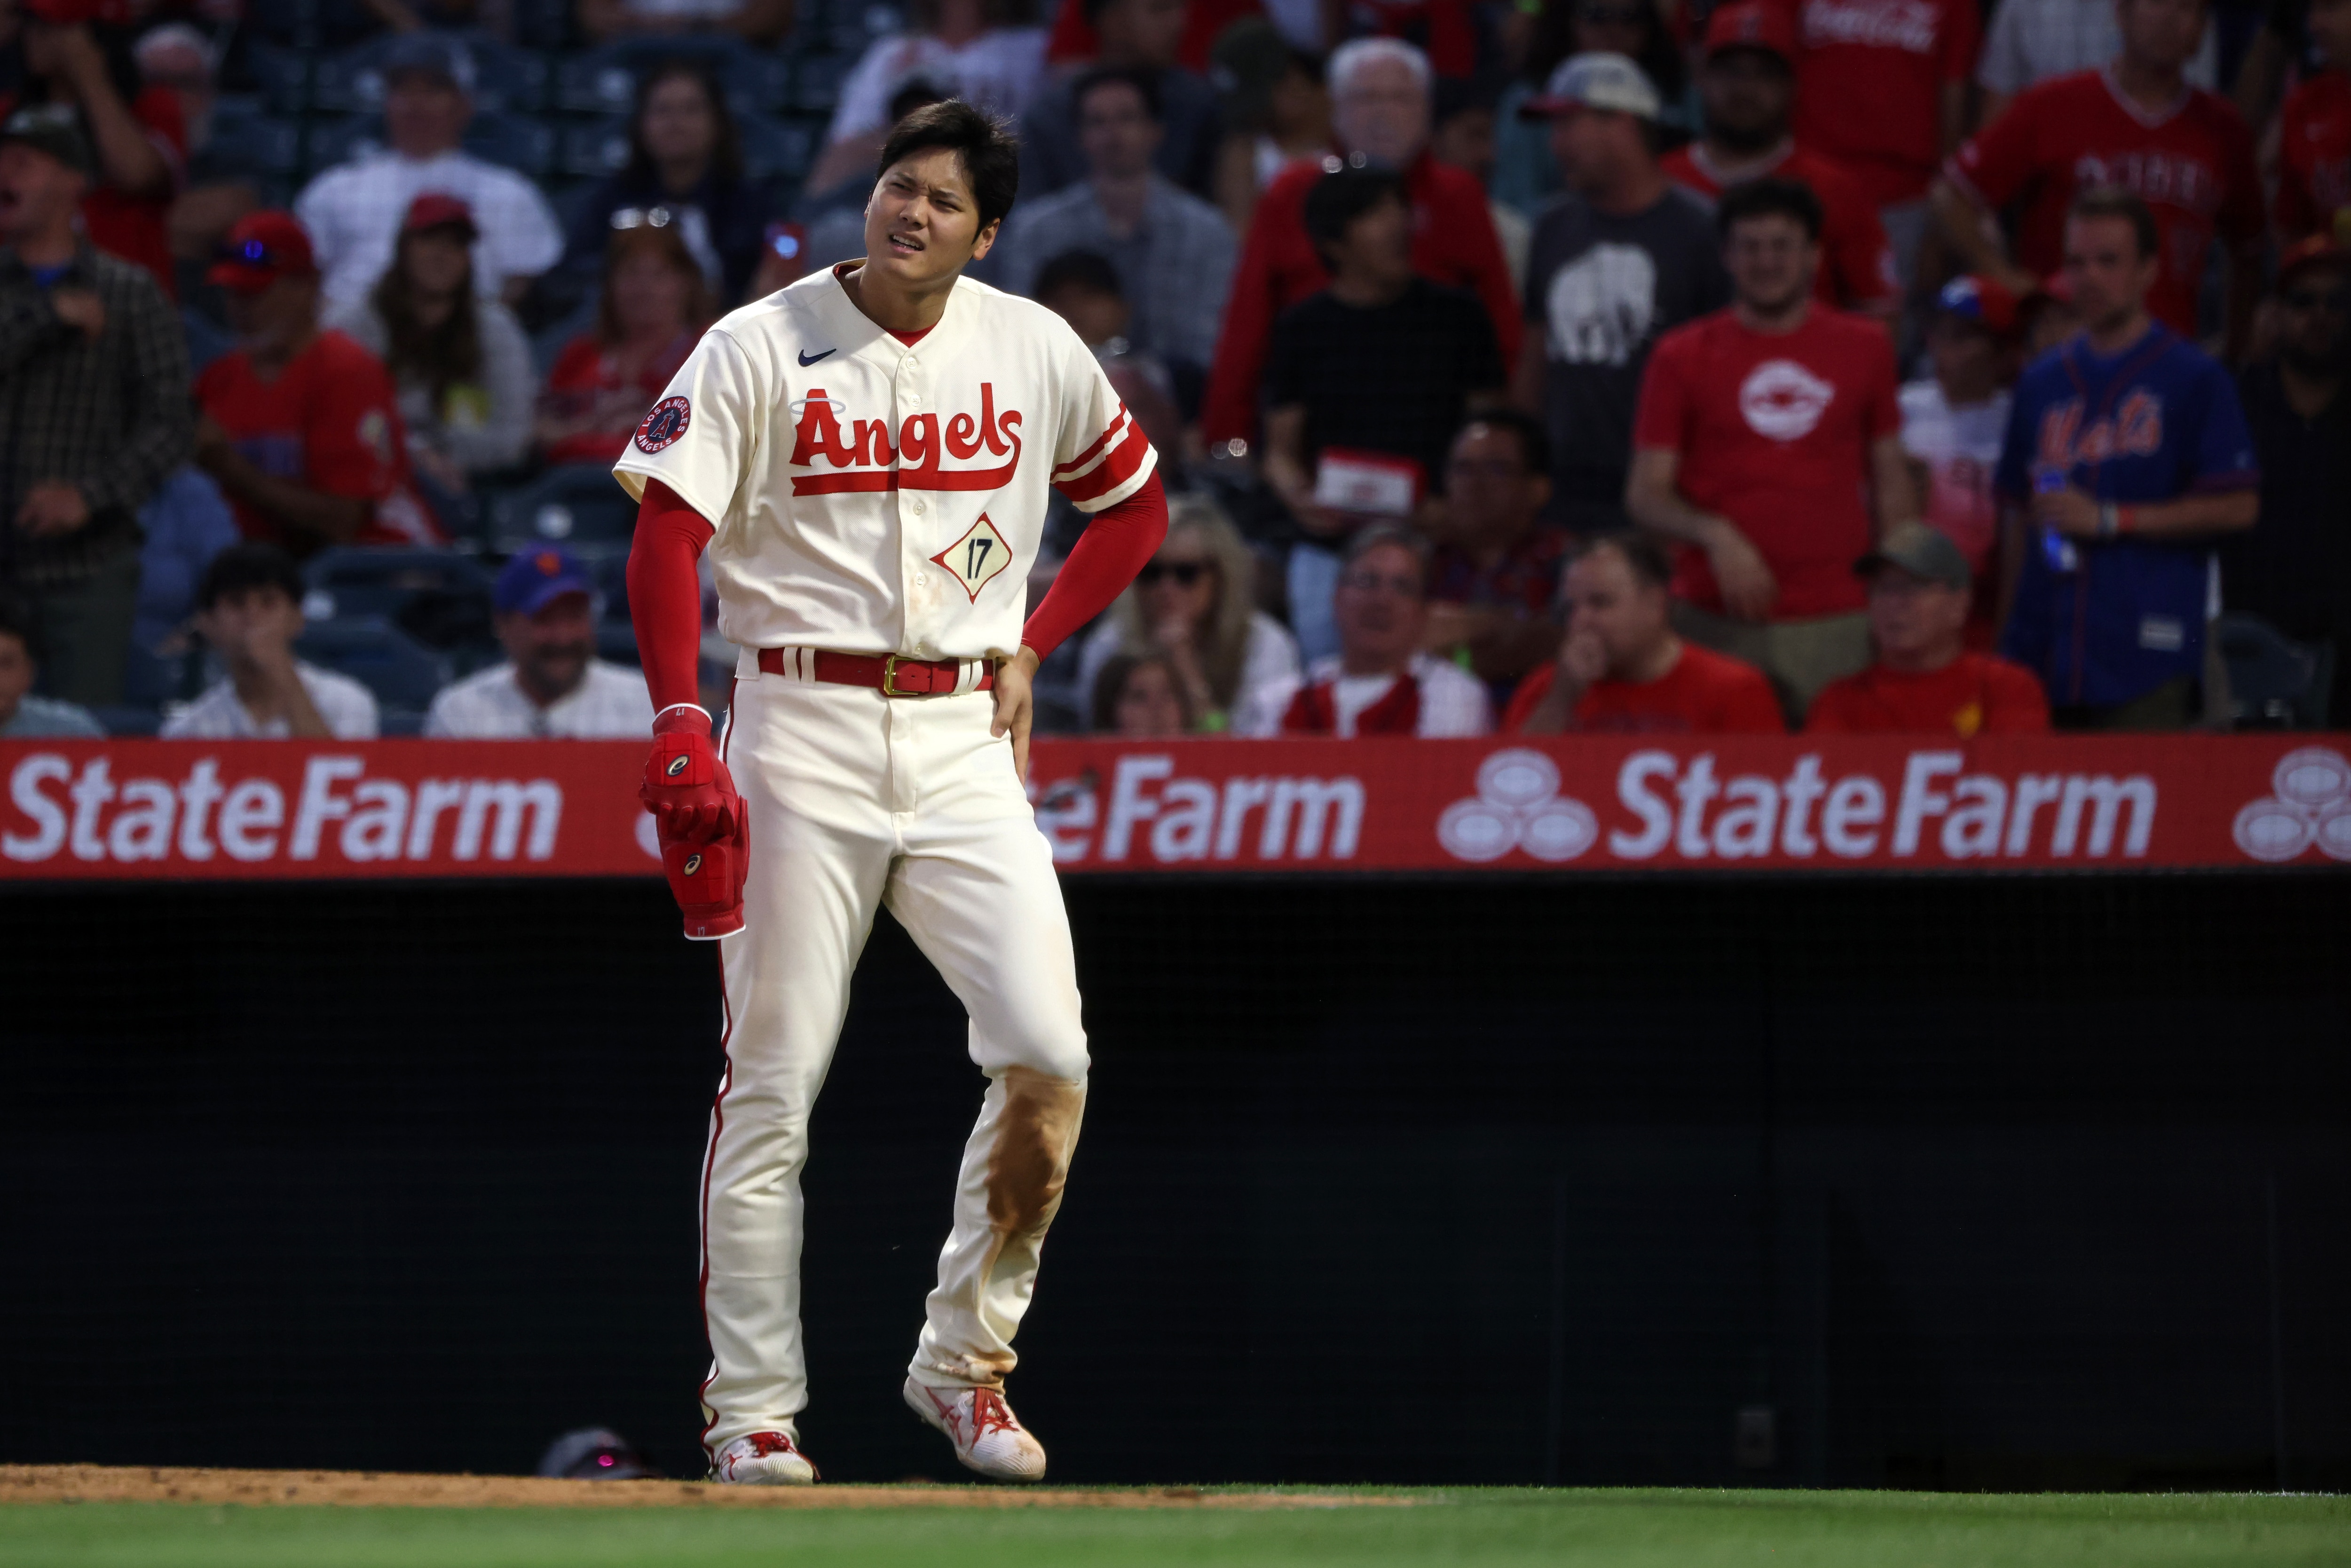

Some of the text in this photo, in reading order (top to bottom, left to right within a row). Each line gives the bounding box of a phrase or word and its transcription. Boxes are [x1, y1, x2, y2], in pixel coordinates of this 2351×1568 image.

[642, 399, 688, 432] LOS ANGELES
[638, 434, 672, 451] ANGELS
[789, 382, 1022, 494] Angels
[968, 538, 993, 580] 17
[697, 926, 705, 937] 17
